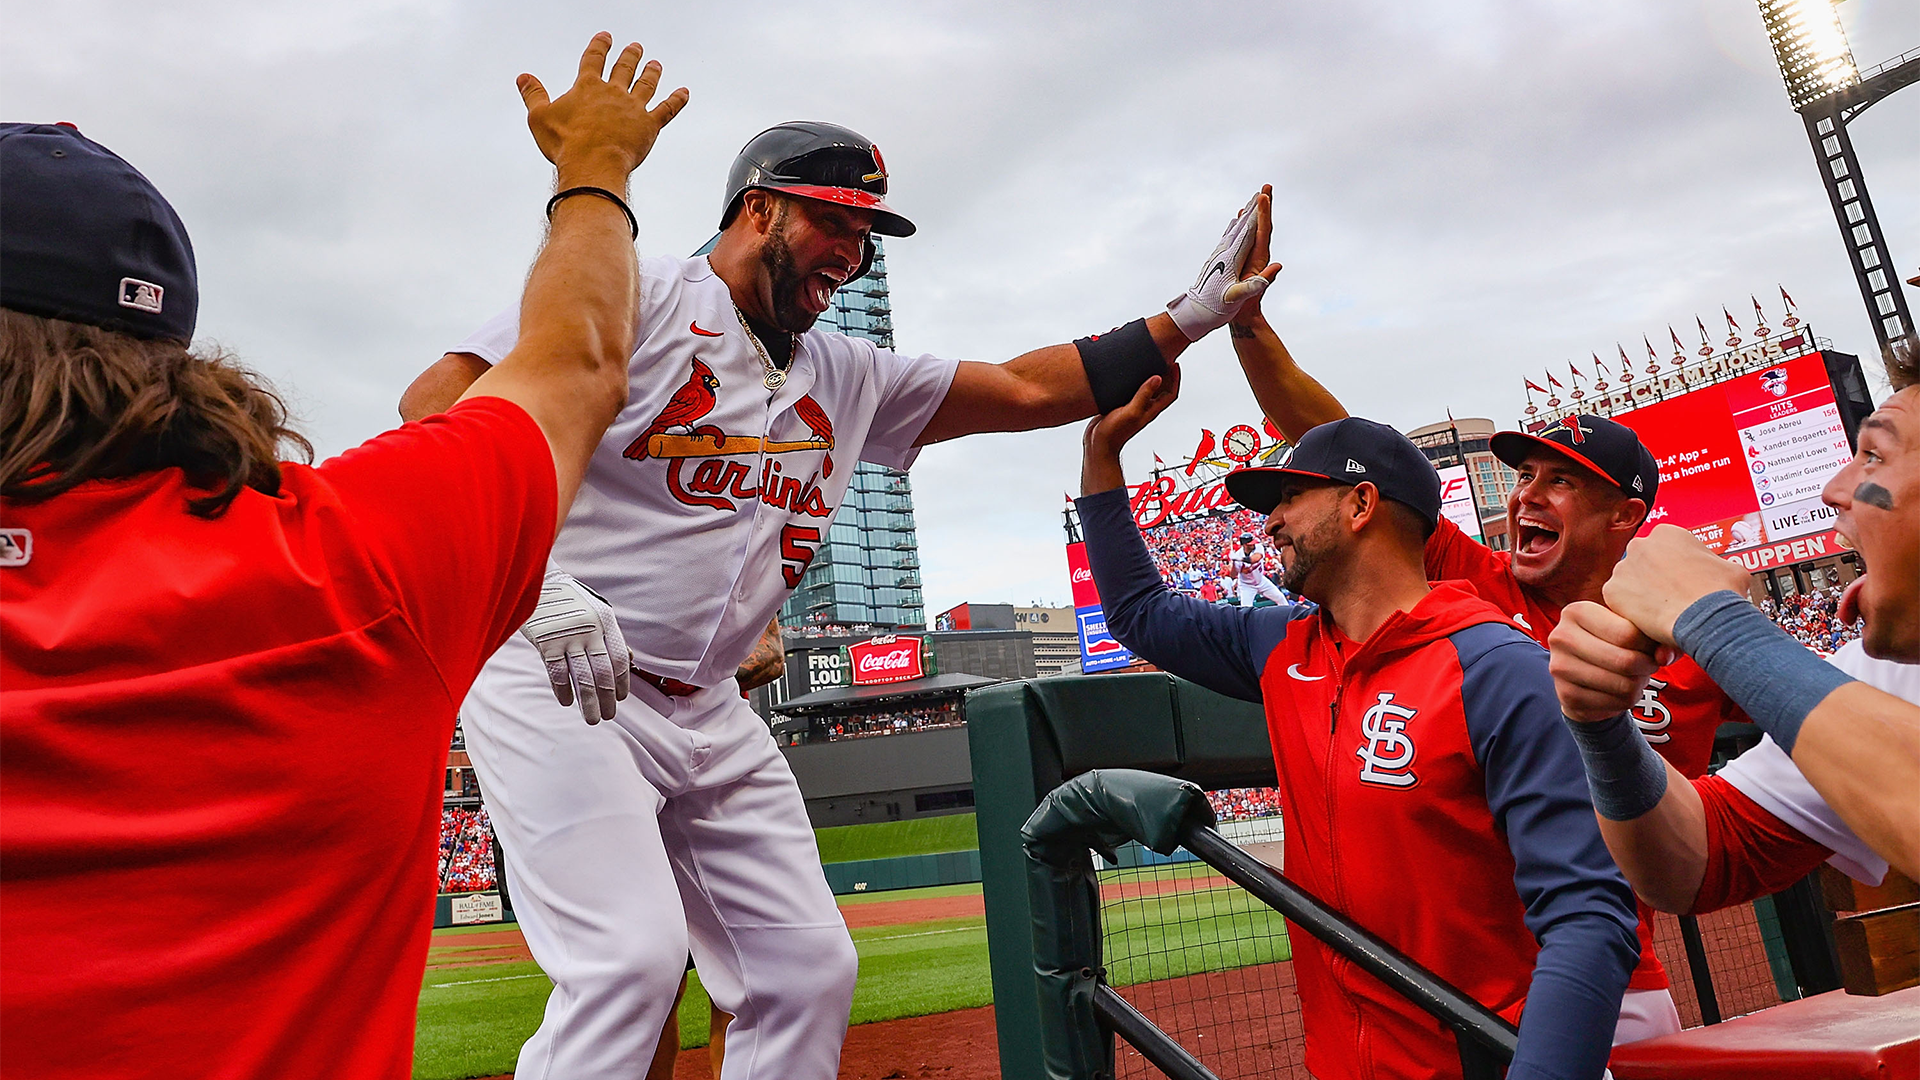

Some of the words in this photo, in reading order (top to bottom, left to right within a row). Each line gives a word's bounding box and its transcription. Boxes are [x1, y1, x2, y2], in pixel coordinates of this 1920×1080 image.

[1783, 317, 1798, 327] 2011
[1631, 341, 1783, 402] CHAMPIONS
[1770, 400, 1793, 413] HITS
[1770, 407, 1797, 419] LEADERS
[1759, 427, 1776, 436] Jose
[1778, 419, 1802, 430] Abreu
[1822, 408, 1837, 418] 156
[1763, 440, 1790, 452] Xander
[1791, 429, 1827, 445] Bogaerts
[1827, 424, 1842, 434] 148
[1679, 450, 1699, 463] App
[1767, 452, 1805, 468] Nathaniel
[1806, 446, 1828, 457] Lowe
[1833, 440, 1847, 450] 147
[1673, 471, 1680, 479] a
[1681, 462, 1711, 477] home
[1712, 457, 1731, 468] run
[1772, 469, 1802, 483] Vladimir
[1804, 461, 1837, 475] Guerrero
[1837, 456, 1852, 466] 144
[667, 457, 834, 518] Cardinls
[1777, 490, 1793, 500] Luis
[1795, 483, 1821, 495] Arraez
[1772, 515, 1800, 530] LIVE
[1708, 529, 1723, 540] OFF
[780, 523, 821, 590] 5
[1086, 622, 1106, 631] SHELT
[871, 634, 897, 646] Coca-Cola
[808, 654, 840, 669] FRO
[860, 649, 912, 672] Coca-Cola
[809, 670, 841, 685] LOU
